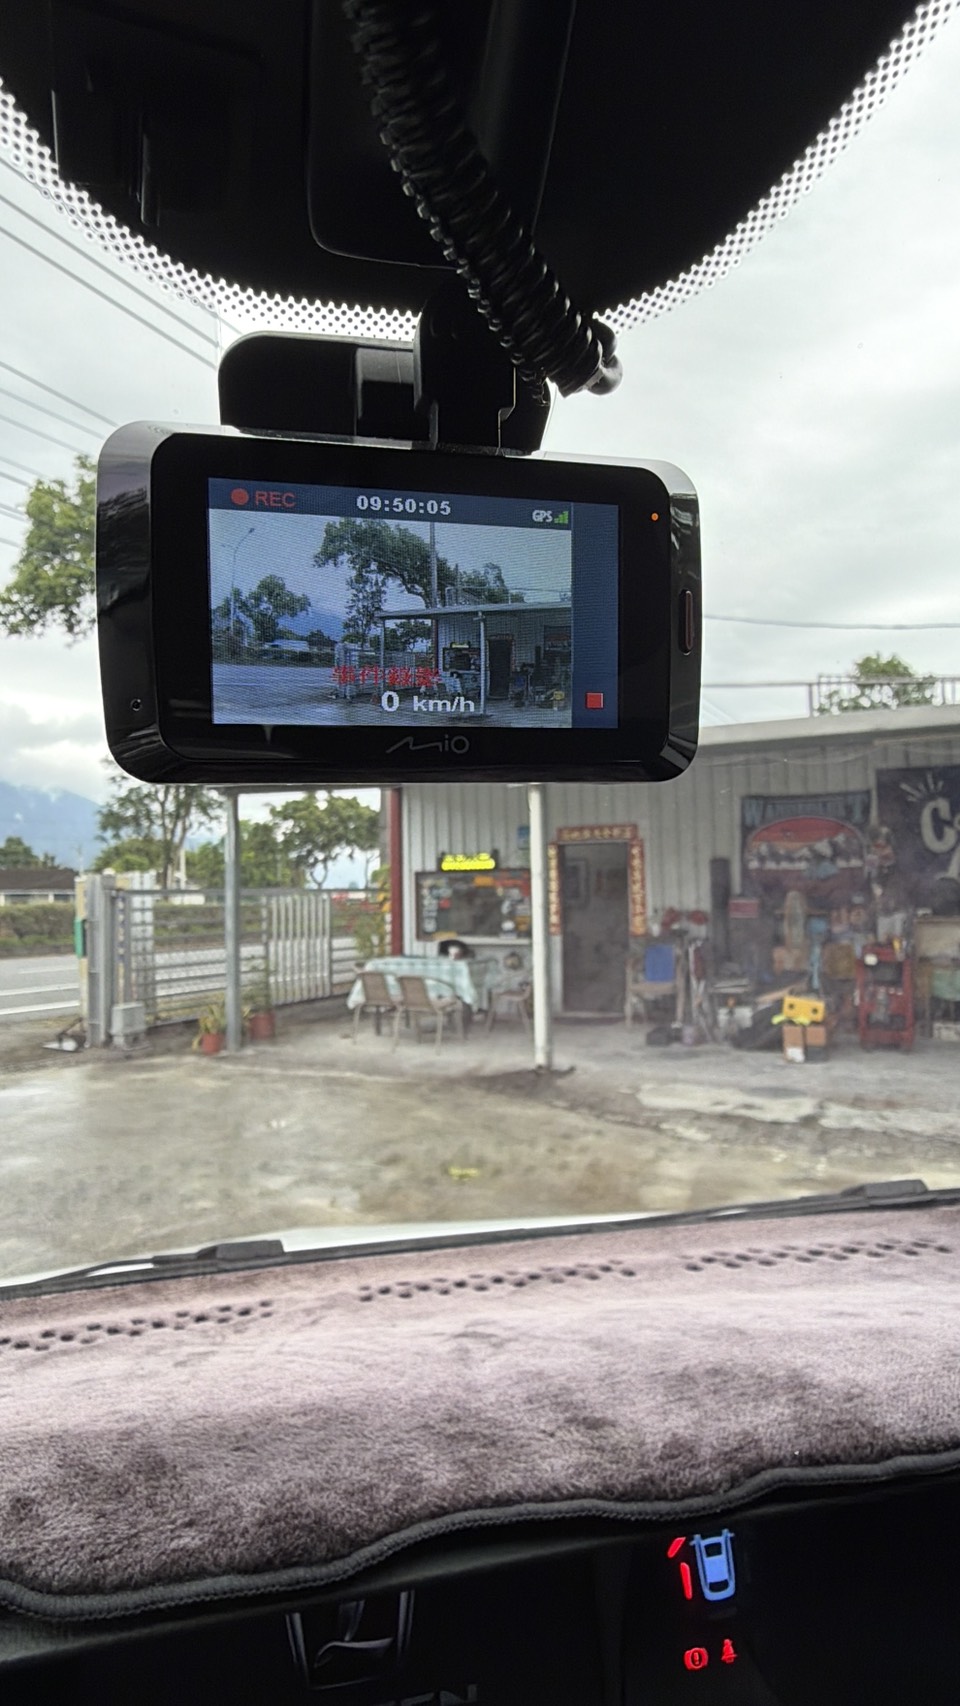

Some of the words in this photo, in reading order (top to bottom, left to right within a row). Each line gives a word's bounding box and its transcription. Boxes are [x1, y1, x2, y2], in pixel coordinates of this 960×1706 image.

[255, 490, 296, 508] REC
[356, 495, 452, 516] 09:50:05
[532, 509, 553, 523] GPS
[381, 690, 399, 712] 0
[413, 695, 475, 713] km/h
